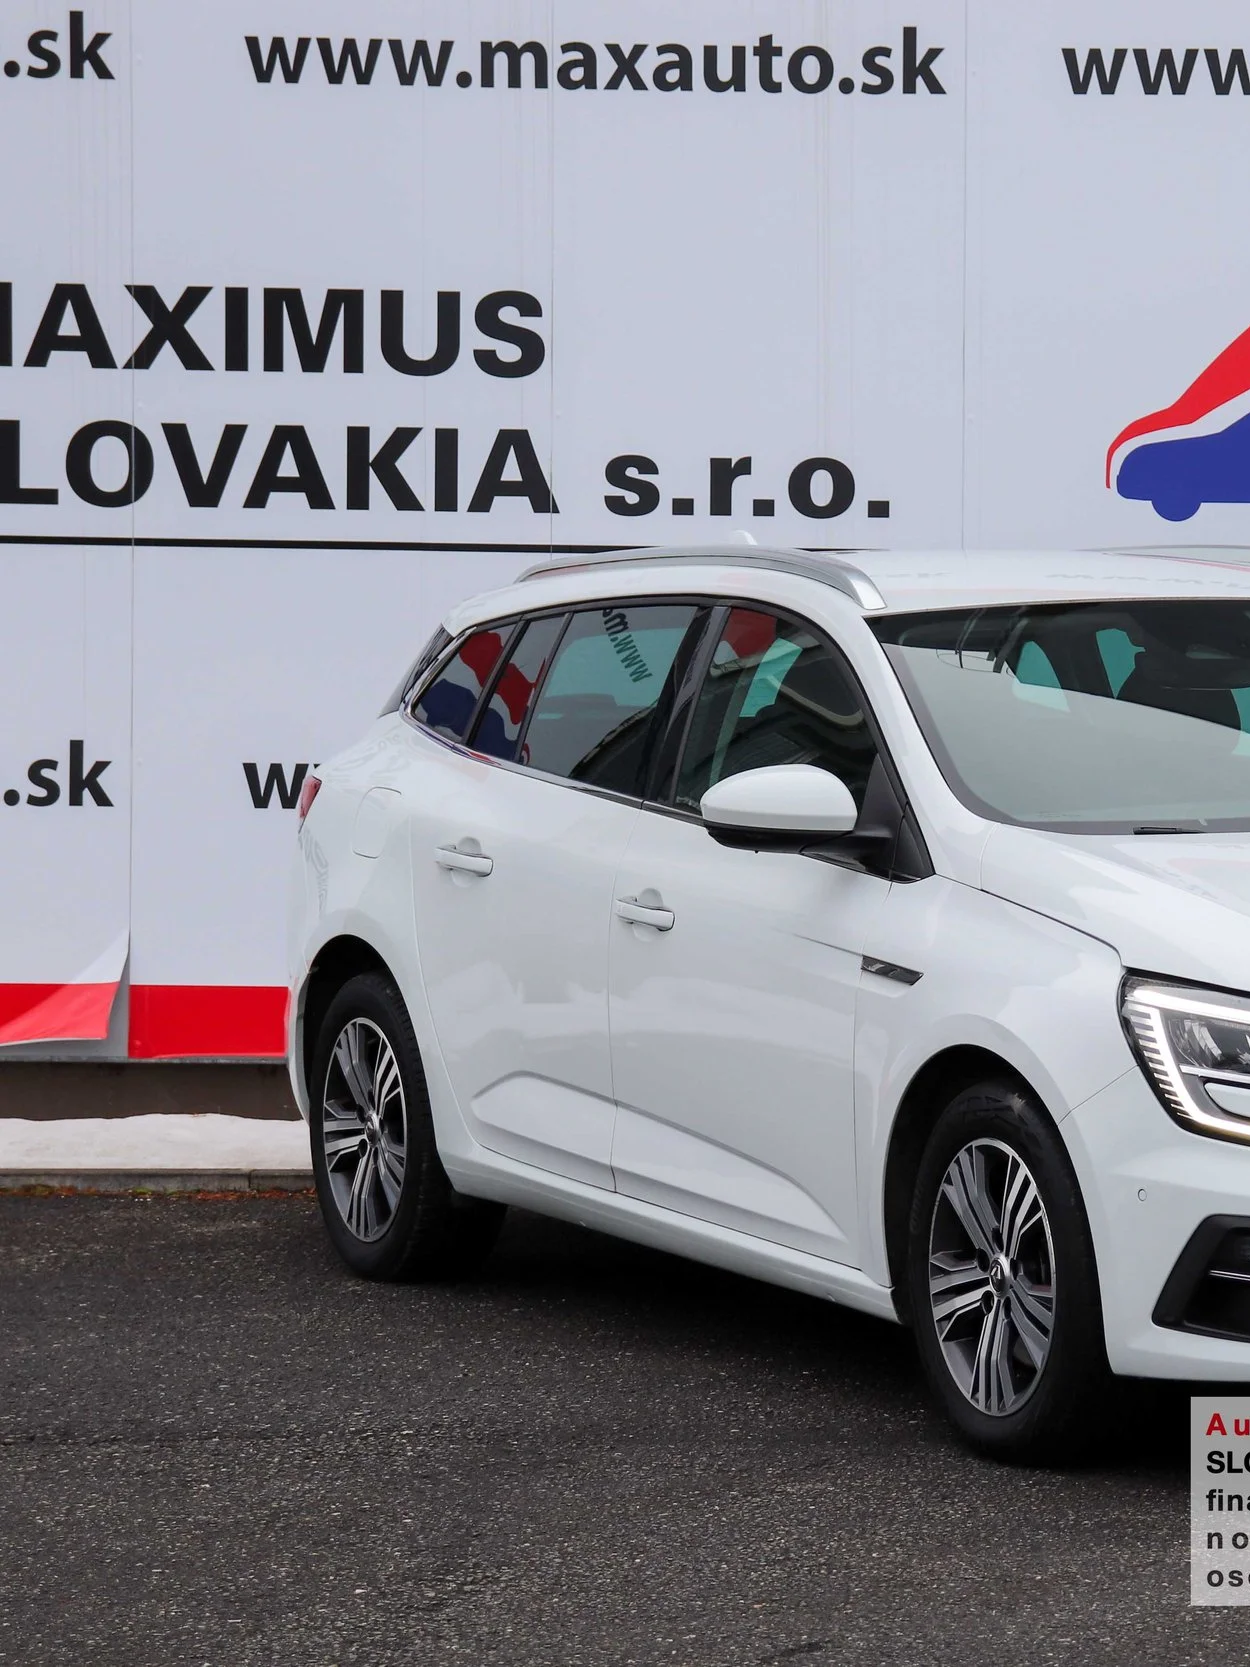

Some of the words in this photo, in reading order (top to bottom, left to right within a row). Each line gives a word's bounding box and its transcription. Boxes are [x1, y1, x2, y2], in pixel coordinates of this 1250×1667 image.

[245, 27, 946, 95] www.maxauto.sk
[0, 282, 545, 378] AXIMUS
[605, 455, 889, 519] s.r.o.
